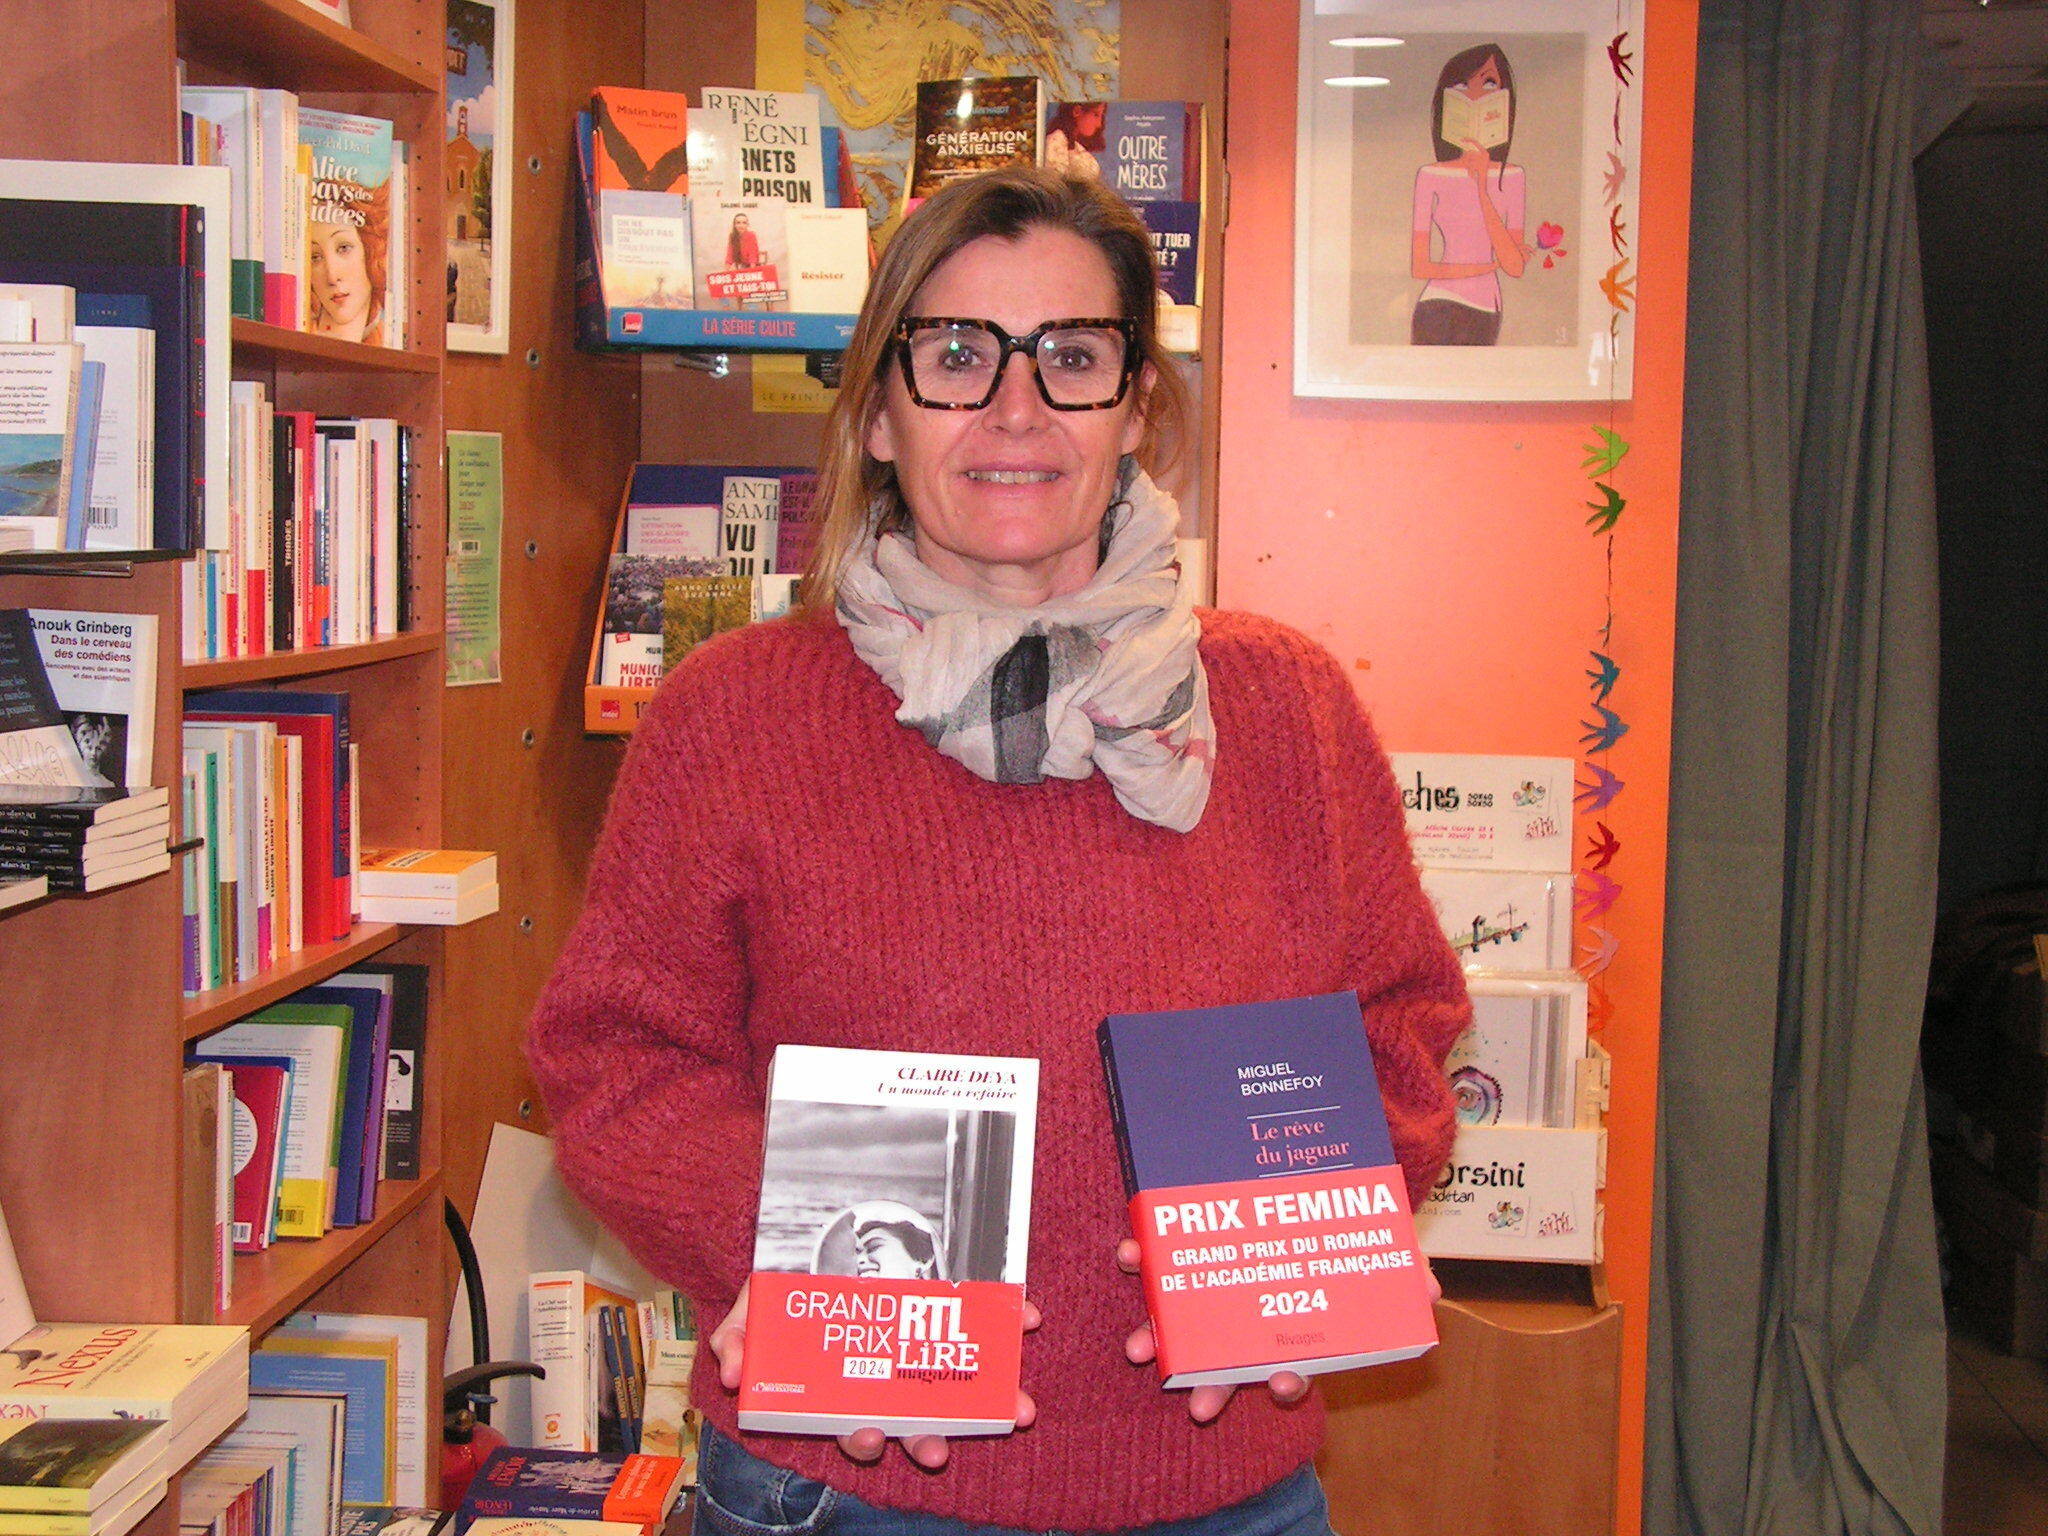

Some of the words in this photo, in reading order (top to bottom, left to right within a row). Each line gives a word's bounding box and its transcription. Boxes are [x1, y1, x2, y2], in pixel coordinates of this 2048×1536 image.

[708, 94, 778, 118] RENÉ
[744, 118, 808, 145] ÉGNI
[926, 130, 1027, 145] GÉNÉRATION
[937, 142, 1016, 156] ANXIEUSE
[1118, 135, 1167, 160] OUTRE
[1117, 161, 1168, 189] MÈRES
[742, 178, 811, 203] PRISON
[311, 197, 366, 228] idées
[702, 318, 719, 336] LA
[721, 316, 756, 336] SÉRIE
[759, 320, 796, 337] CULTE
[725, 524, 756, 552] VU
[29, 617, 71, 633] Anouk
[76, 620, 133, 638] Grinberg
[51, 634, 77, 647] Dans
[80, 635, 90, 647] le
[92, 637, 132, 649] cerveau
[54, 648, 73, 659] des
[77, 650, 132, 663] comédiens
[620, 663, 662, 676] MUNICI
[1402, 771, 1460, 812] ches
[897, 1067, 963, 1082] CLAIRE
[968, 1070, 1016, 1084] DEYA
[1237, 1062, 1295, 1080] MIGUEL
[901, 1085, 949, 1096] monde
[965, 1088, 1017, 1100] refaire
[1241, 1075, 1323, 1096] BONNEFOY
[1250, 1122, 1279, 1142] Le
[1284, 1119, 1325, 1136] rêve
[1255, 1146, 1281, 1165] du
[1285, 1140, 1350, 1168] jaguar
[1154, 1198, 1245, 1237] PRIX
[1253, 1183, 1399, 1227] FEMINA
[1172, 1244, 1238, 1267] GRAND
[1243, 1238, 1289, 1259] PRIX
[1293, 1235, 1319, 1255] DU
[1323, 1229, 1393, 1252] ROMAN
[1160, 1274, 1188, 1293] DE
[1191, 1262, 1304, 1289] L'ACADÉMIE
[1308, 1249, 1414, 1280] FRANÇAISE
[785, 1290, 897, 1322] GRAND
[898, 1294, 969, 1342] RTL
[1259, 1289, 1329, 1318] 2024
[823, 1324, 895, 1354] PRIX
[1276, 1330, 1326, 1347] Rivages
[848, 1359, 886, 1376] 2024
[896, 1369, 978, 1384] magazine
